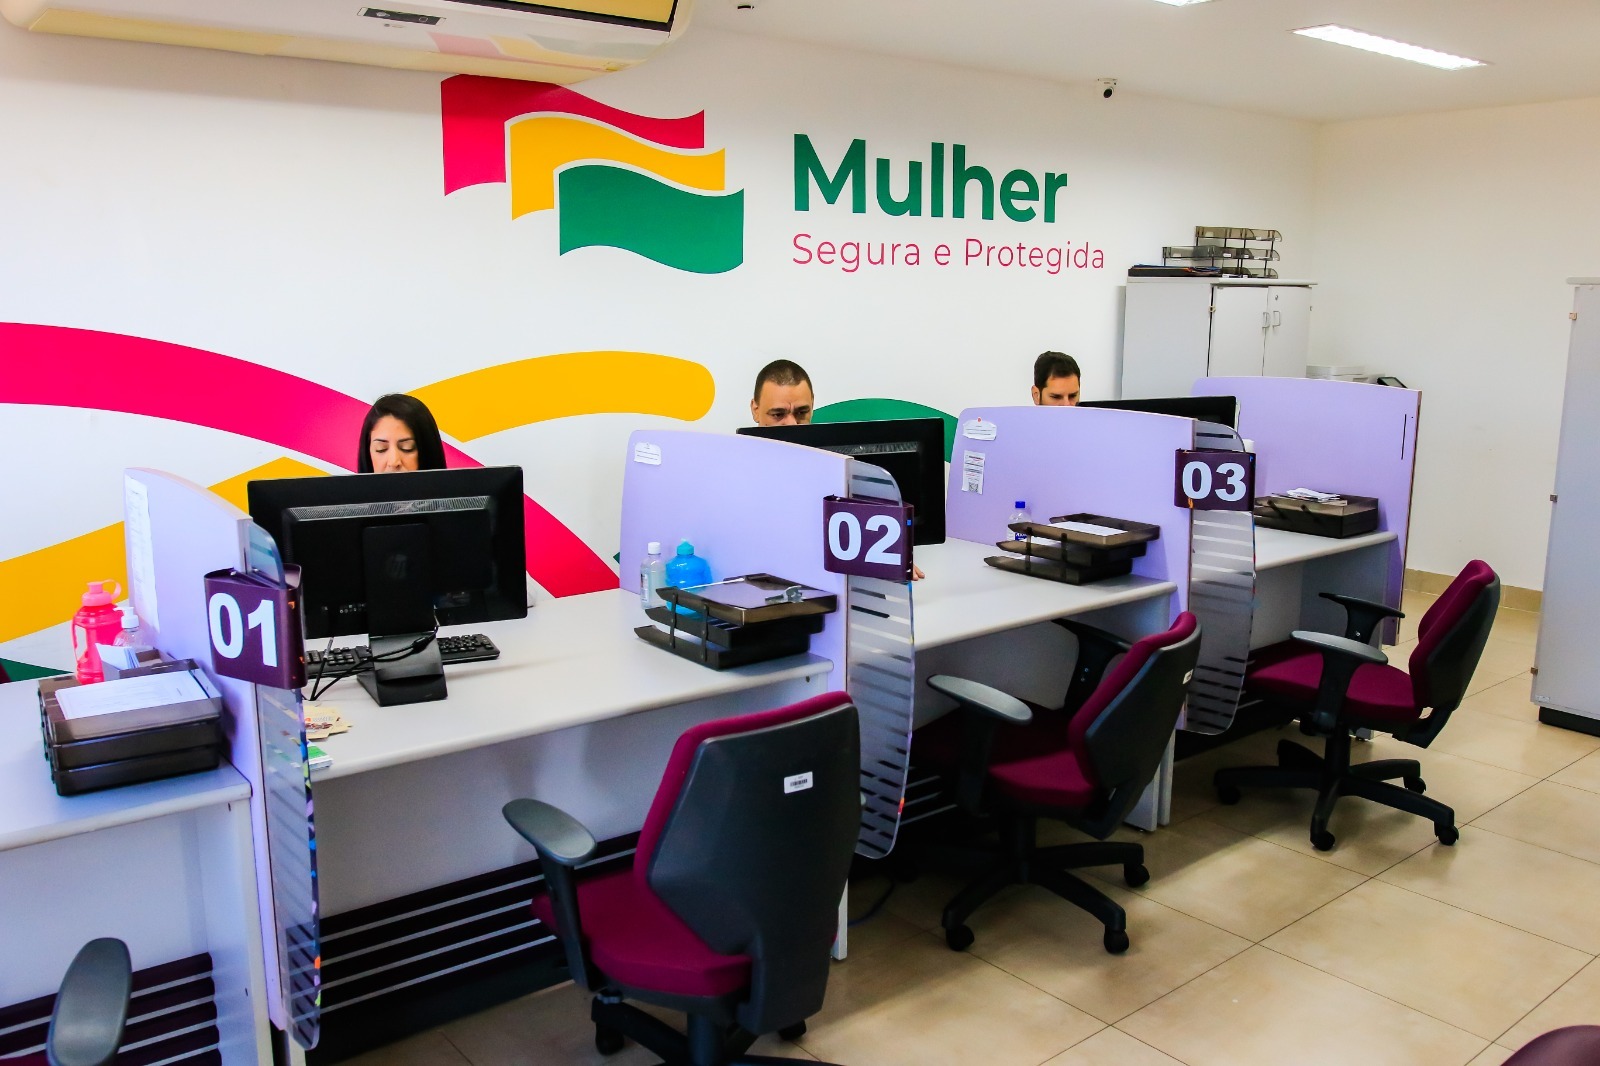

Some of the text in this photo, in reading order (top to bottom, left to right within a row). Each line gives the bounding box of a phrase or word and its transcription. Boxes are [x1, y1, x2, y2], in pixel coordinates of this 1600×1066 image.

[793, 133, 1067, 223] Mulher
[792, 233, 1104, 275] Segura e Protegida
[1182, 461, 1247, 502] 03
[827, 511, 902, 565] 02
[208, 592, 278, 667] 01
